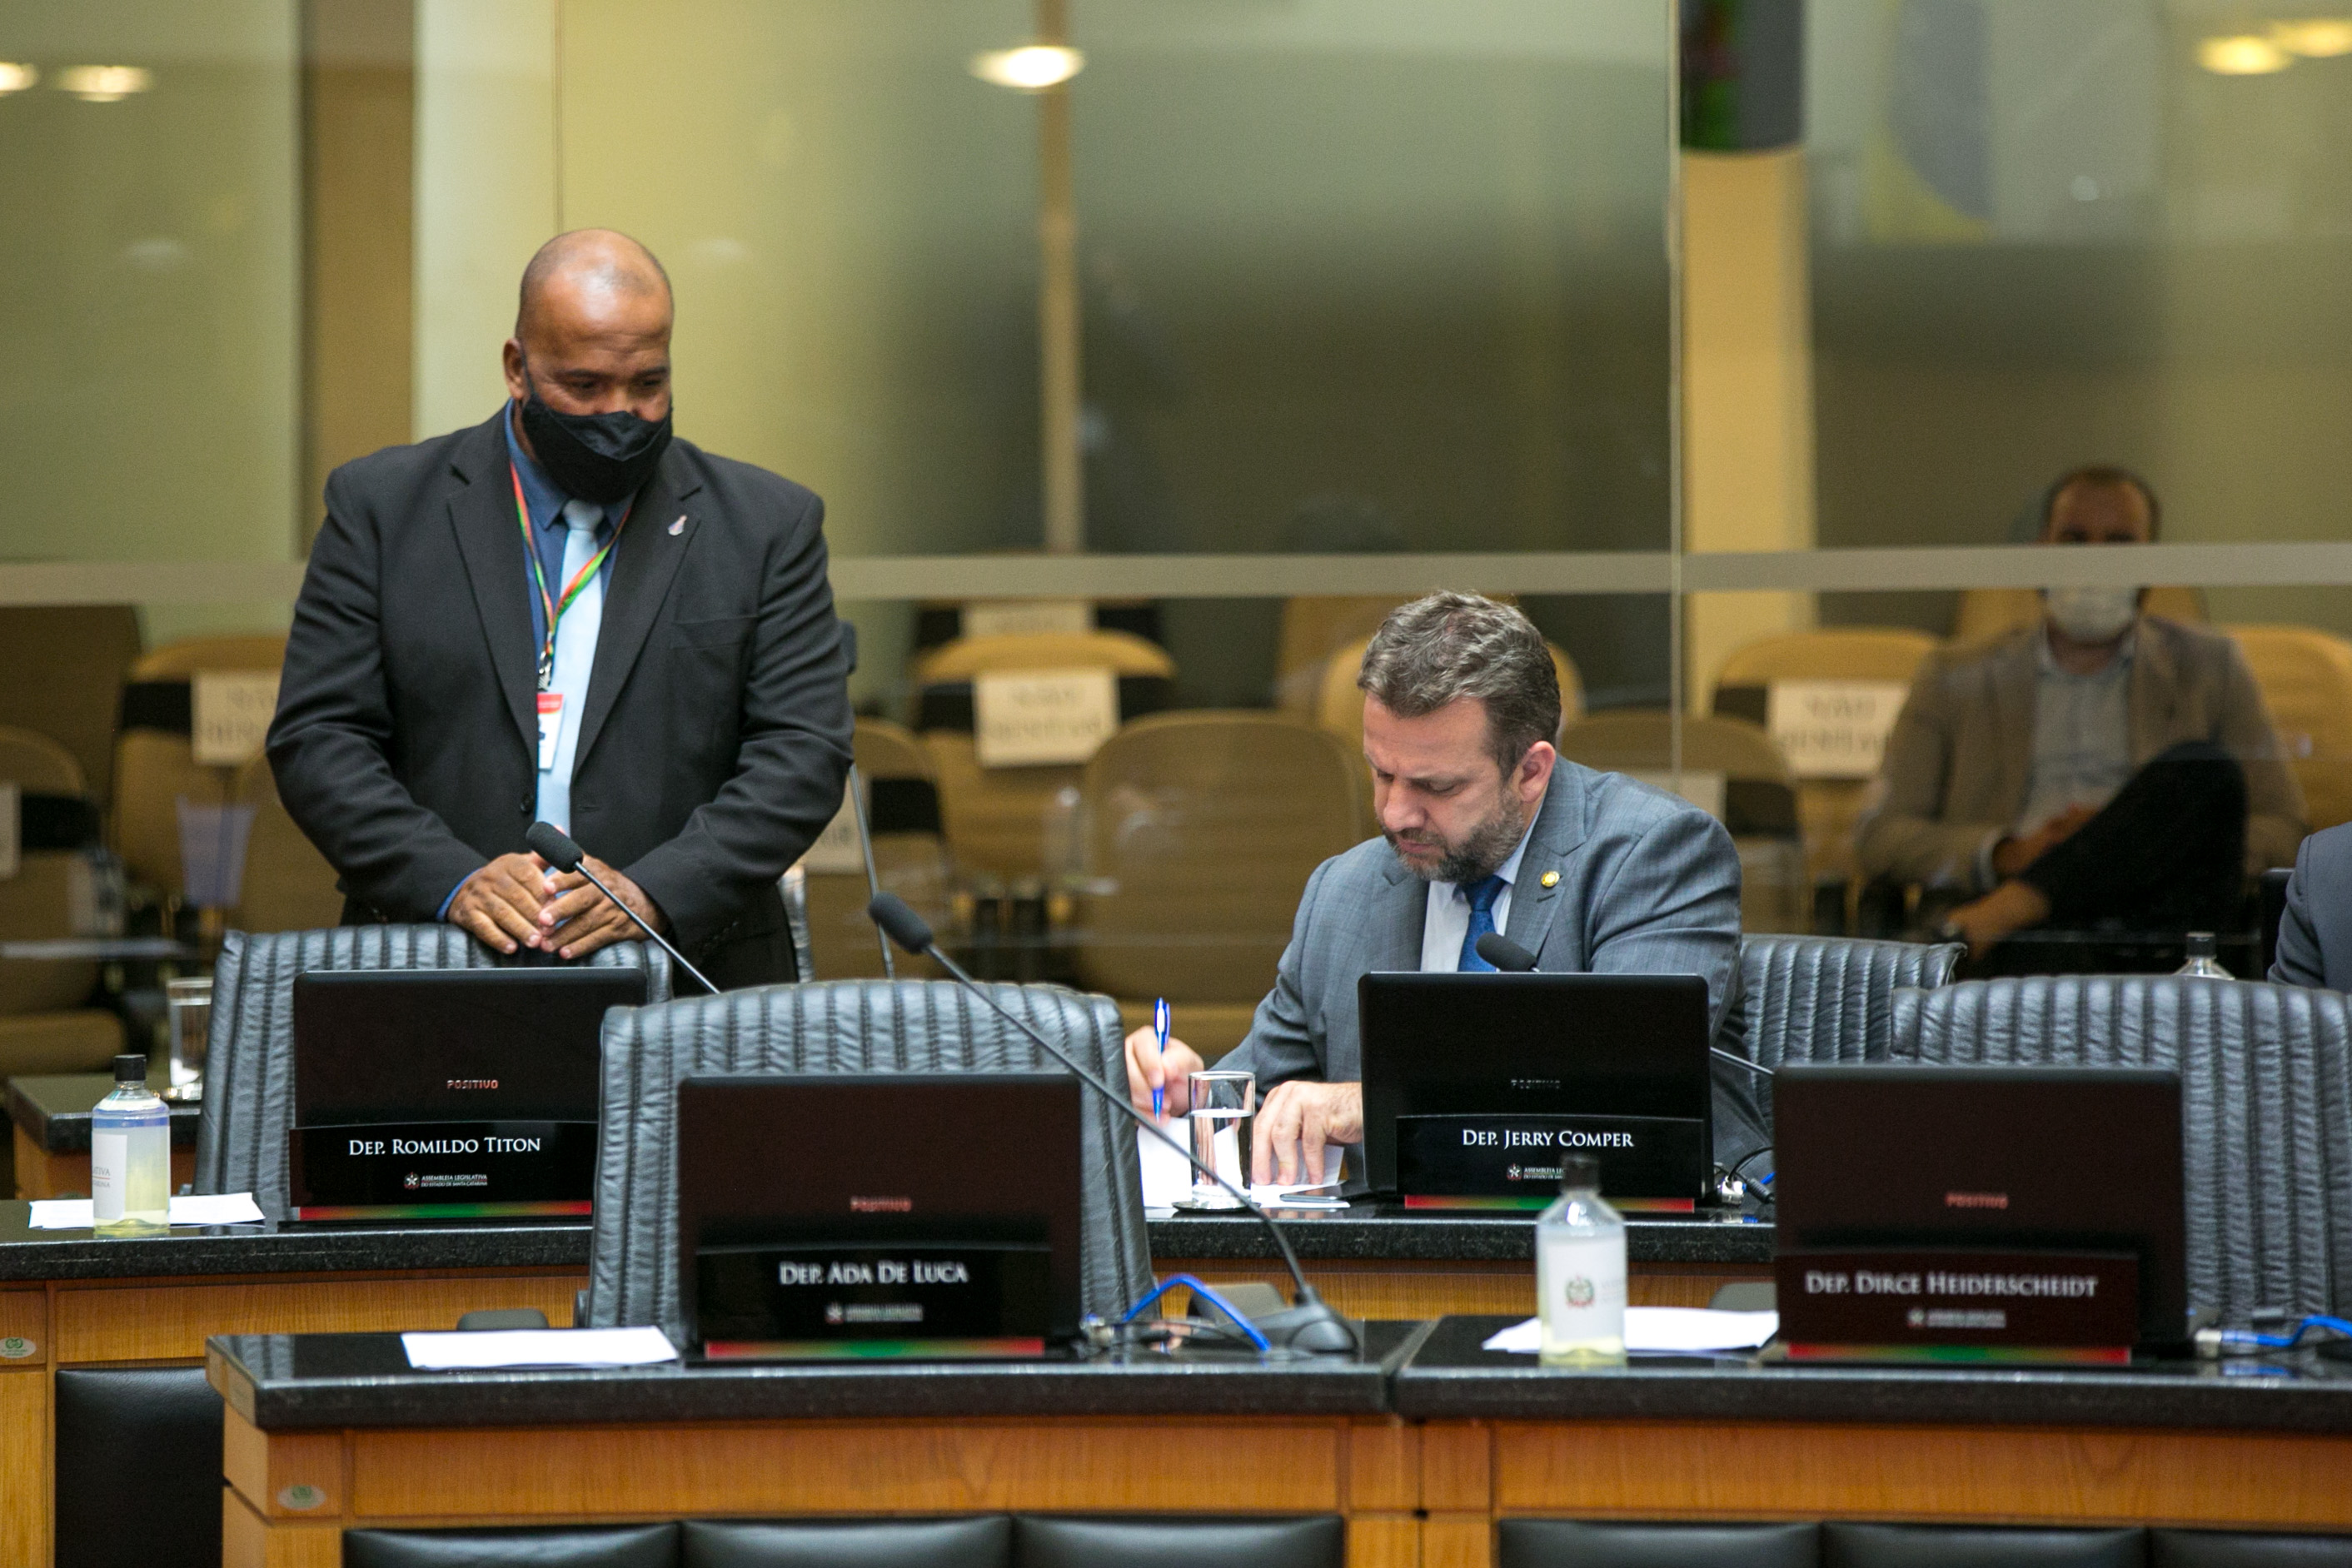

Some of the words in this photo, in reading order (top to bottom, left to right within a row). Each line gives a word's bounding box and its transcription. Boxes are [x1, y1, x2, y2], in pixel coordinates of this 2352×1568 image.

[446, 1079, 499, 1090] POSITIVO
[348, 1139, 386, 1156] DEP.
[391, 1138, 480, 1155] ROMILDO
[484, 1137, 541, 1153] TITON
[1463, 1129, 1498, 1146] DEP.
[1503, 1129, 1554, 1150] JERRY
[1558, 1130, 1635, 1147] COMPER
[779, 1261, 824, 1285] DEP.
[828, 1261, 873, 1284] ADA
[877, 1259, 908, 1284] DE
[913, 1258, 969, 1283] LUCA
[1804, 1270, 1850, 1294] DEP.
[1854, 1270, 1921, 1295] DIRCE
[1926, 1271, 2099, 1297] HEIDERSCHEIDT
